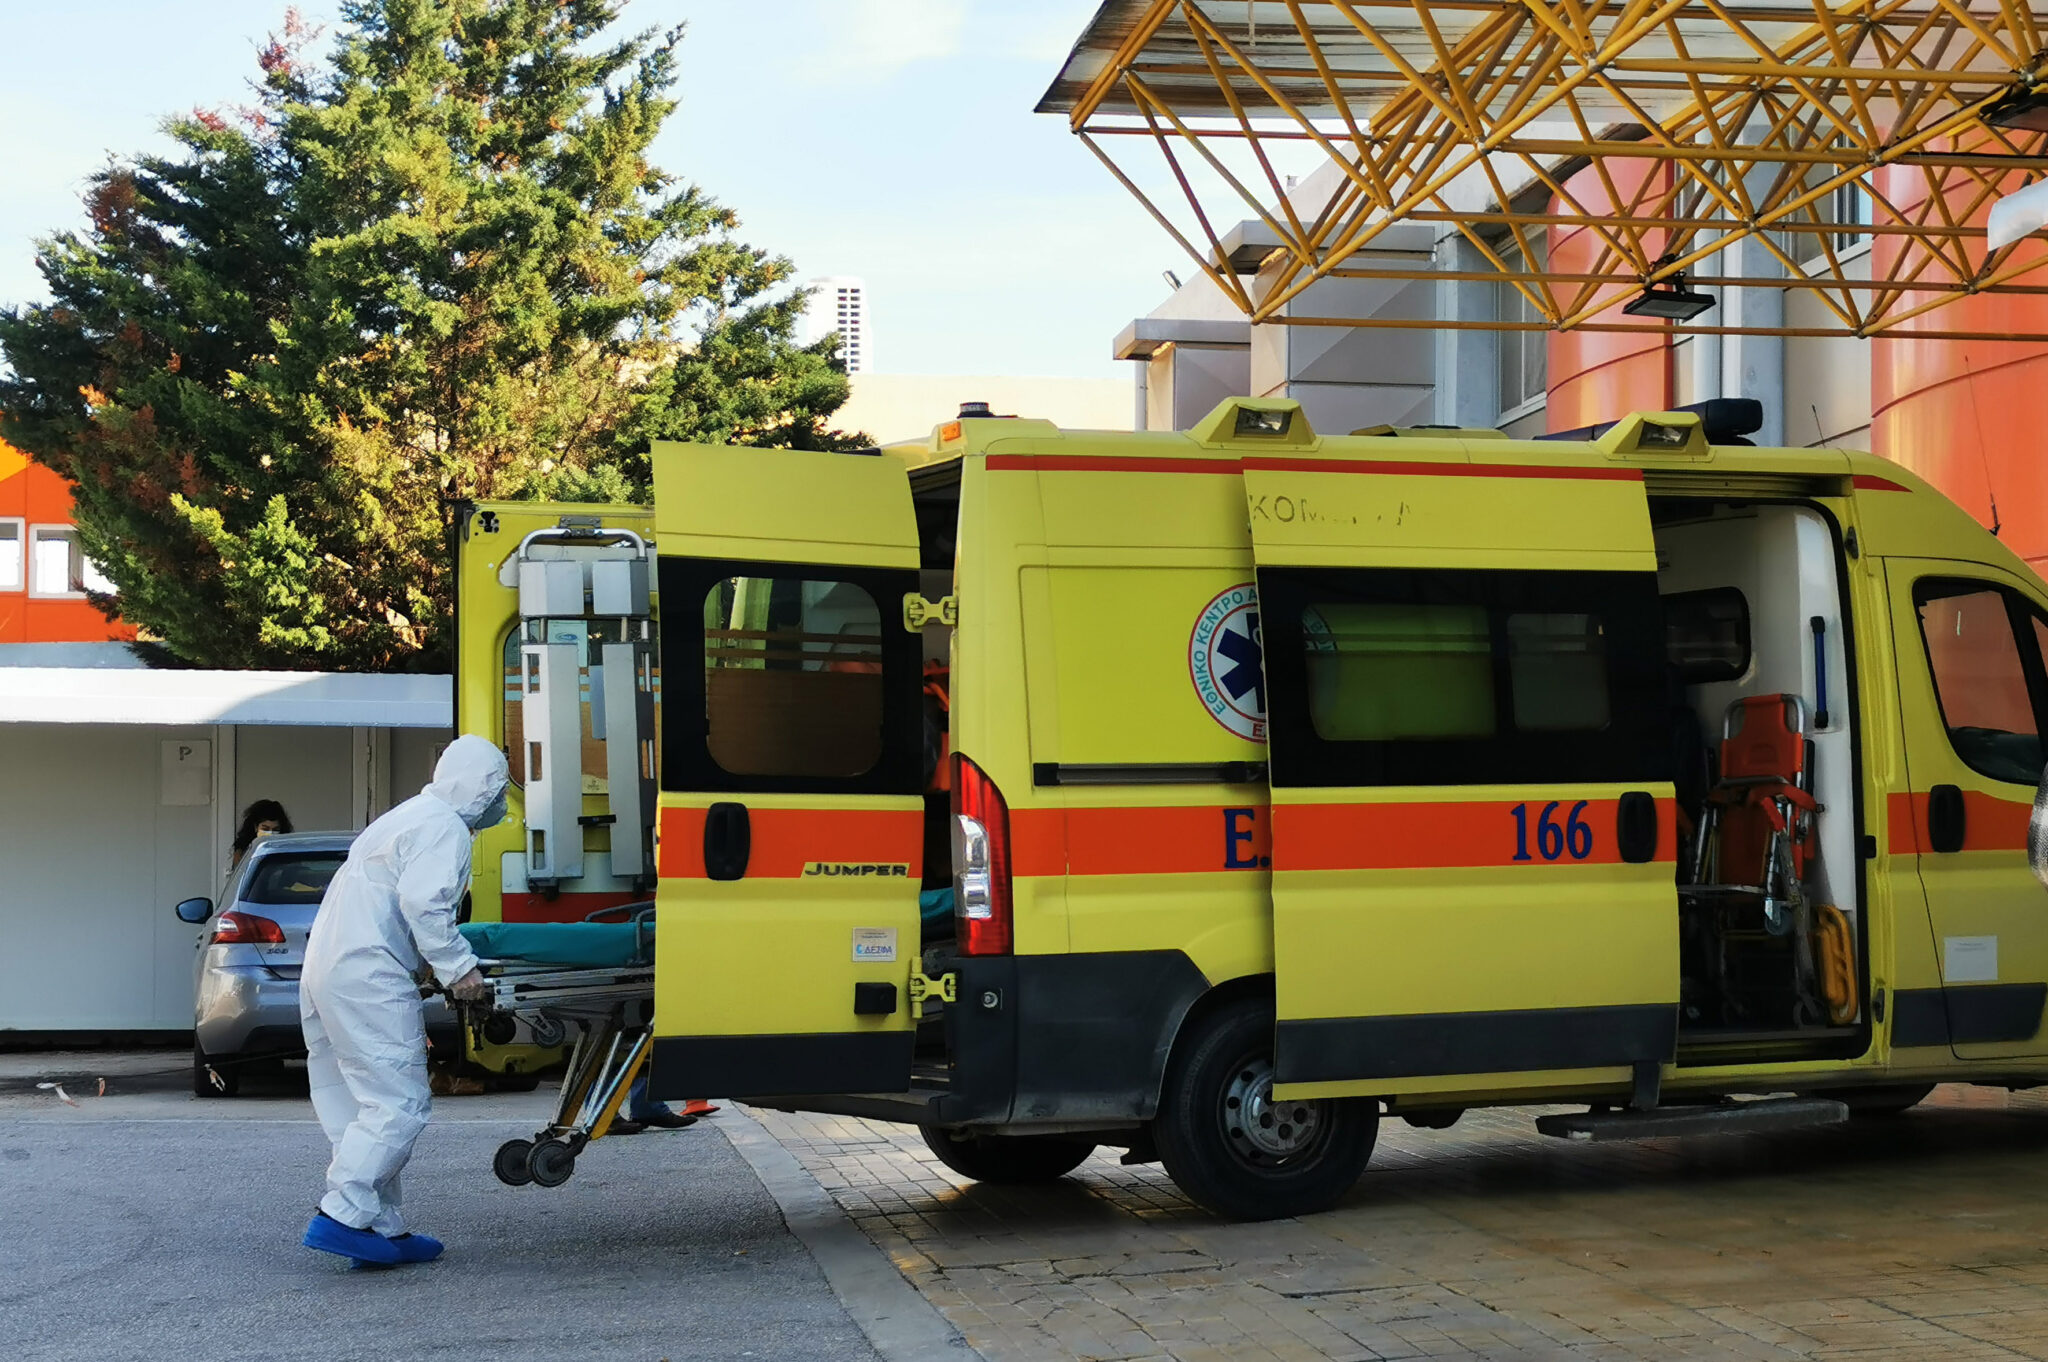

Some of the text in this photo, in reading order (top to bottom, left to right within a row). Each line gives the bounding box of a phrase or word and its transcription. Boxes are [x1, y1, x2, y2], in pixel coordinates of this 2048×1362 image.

[1196, 591, 1243, 645] ΚΕΝΤΡΟ
[1194, 650, 1226, 715] ΕΘΝΙΚΟ
[1511, 800, 1592, 861] 166
[805, 863, 907, 876] JUMPER
